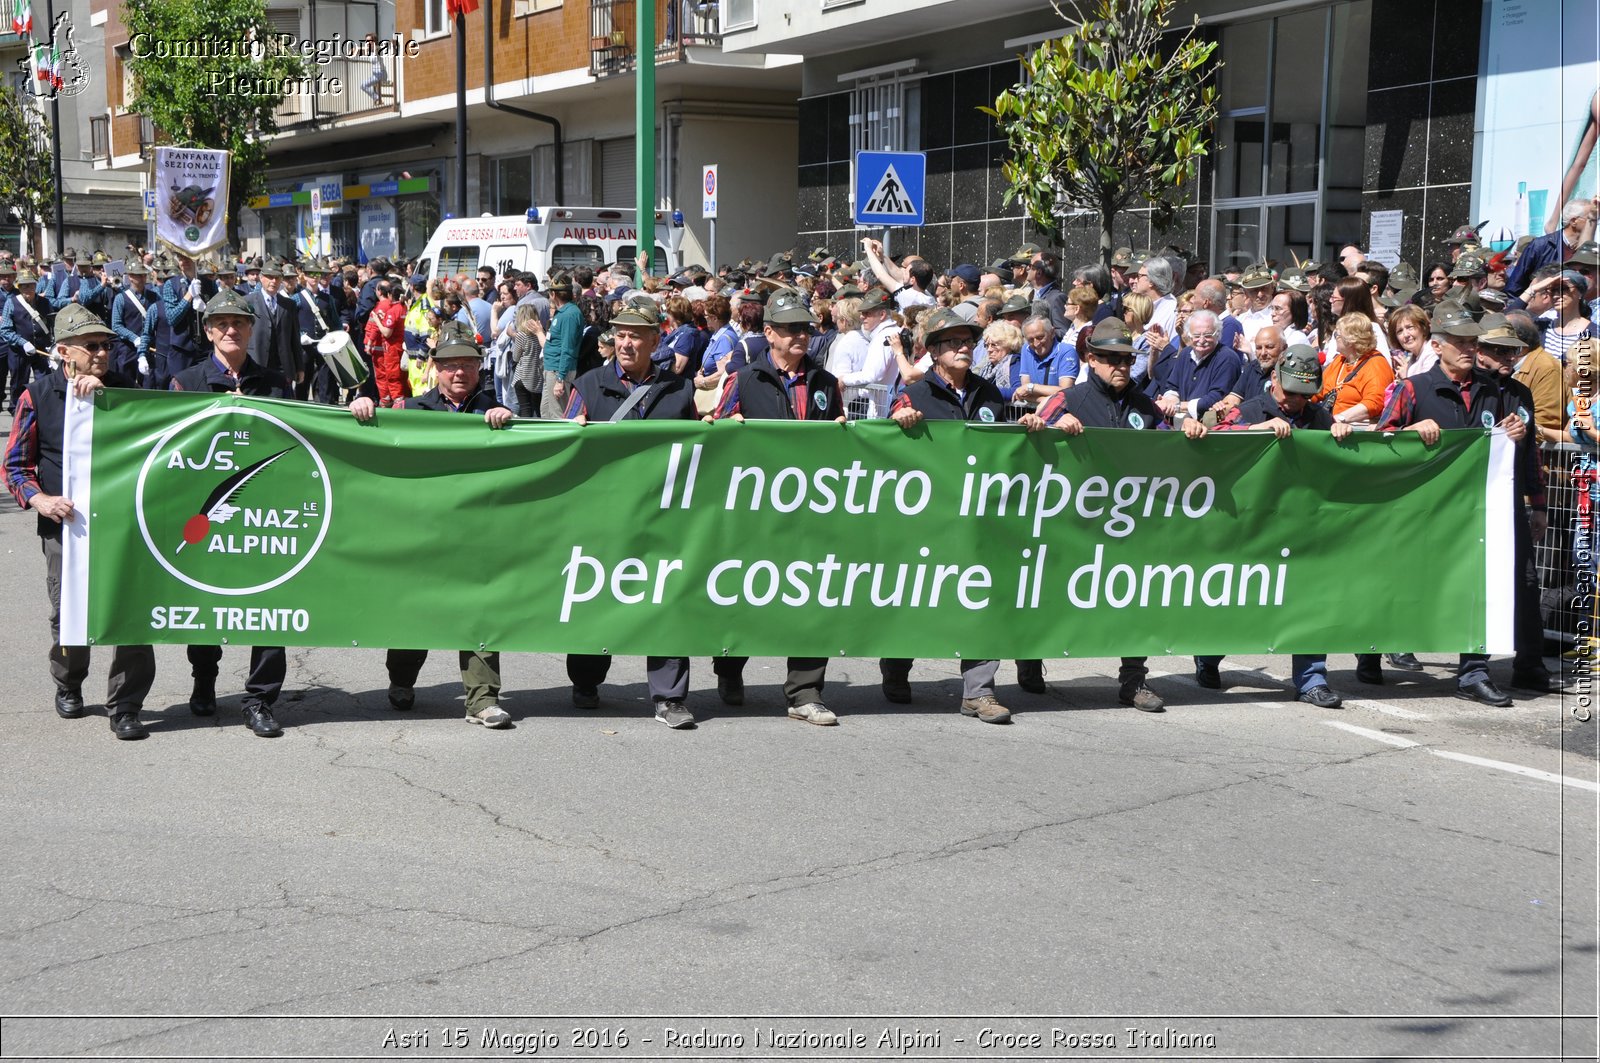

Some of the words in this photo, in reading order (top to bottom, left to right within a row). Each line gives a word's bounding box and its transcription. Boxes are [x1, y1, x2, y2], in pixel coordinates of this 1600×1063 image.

[165, 161, 221, 169] SEZIONALE
[169, 152, 216, 160] FANFARA
[322, 183, 341, 201] EGEA
[447, 229, 470, 241] CROCE
[471, 228, 494, 240] ROSSA
[495, 227, 529, 239] ITALIANA
[563, 227, 656, 240] AMBULAN
[660, 443, 703, 509] Il
[724, 460, 932, 516] nostro
[959, 455, 1216, 538] impegno
[207, 534, 298, 555] ALPINI
[559, 546, 683, 623] per
[706, 546, 992, 610] costruire
[1015, 544, 1047, 609] il
[1067, 544, 1290, 609] domani
[150, 606, 206, 630] SEZ.
[213, 606, 310, 632] TRENTO
